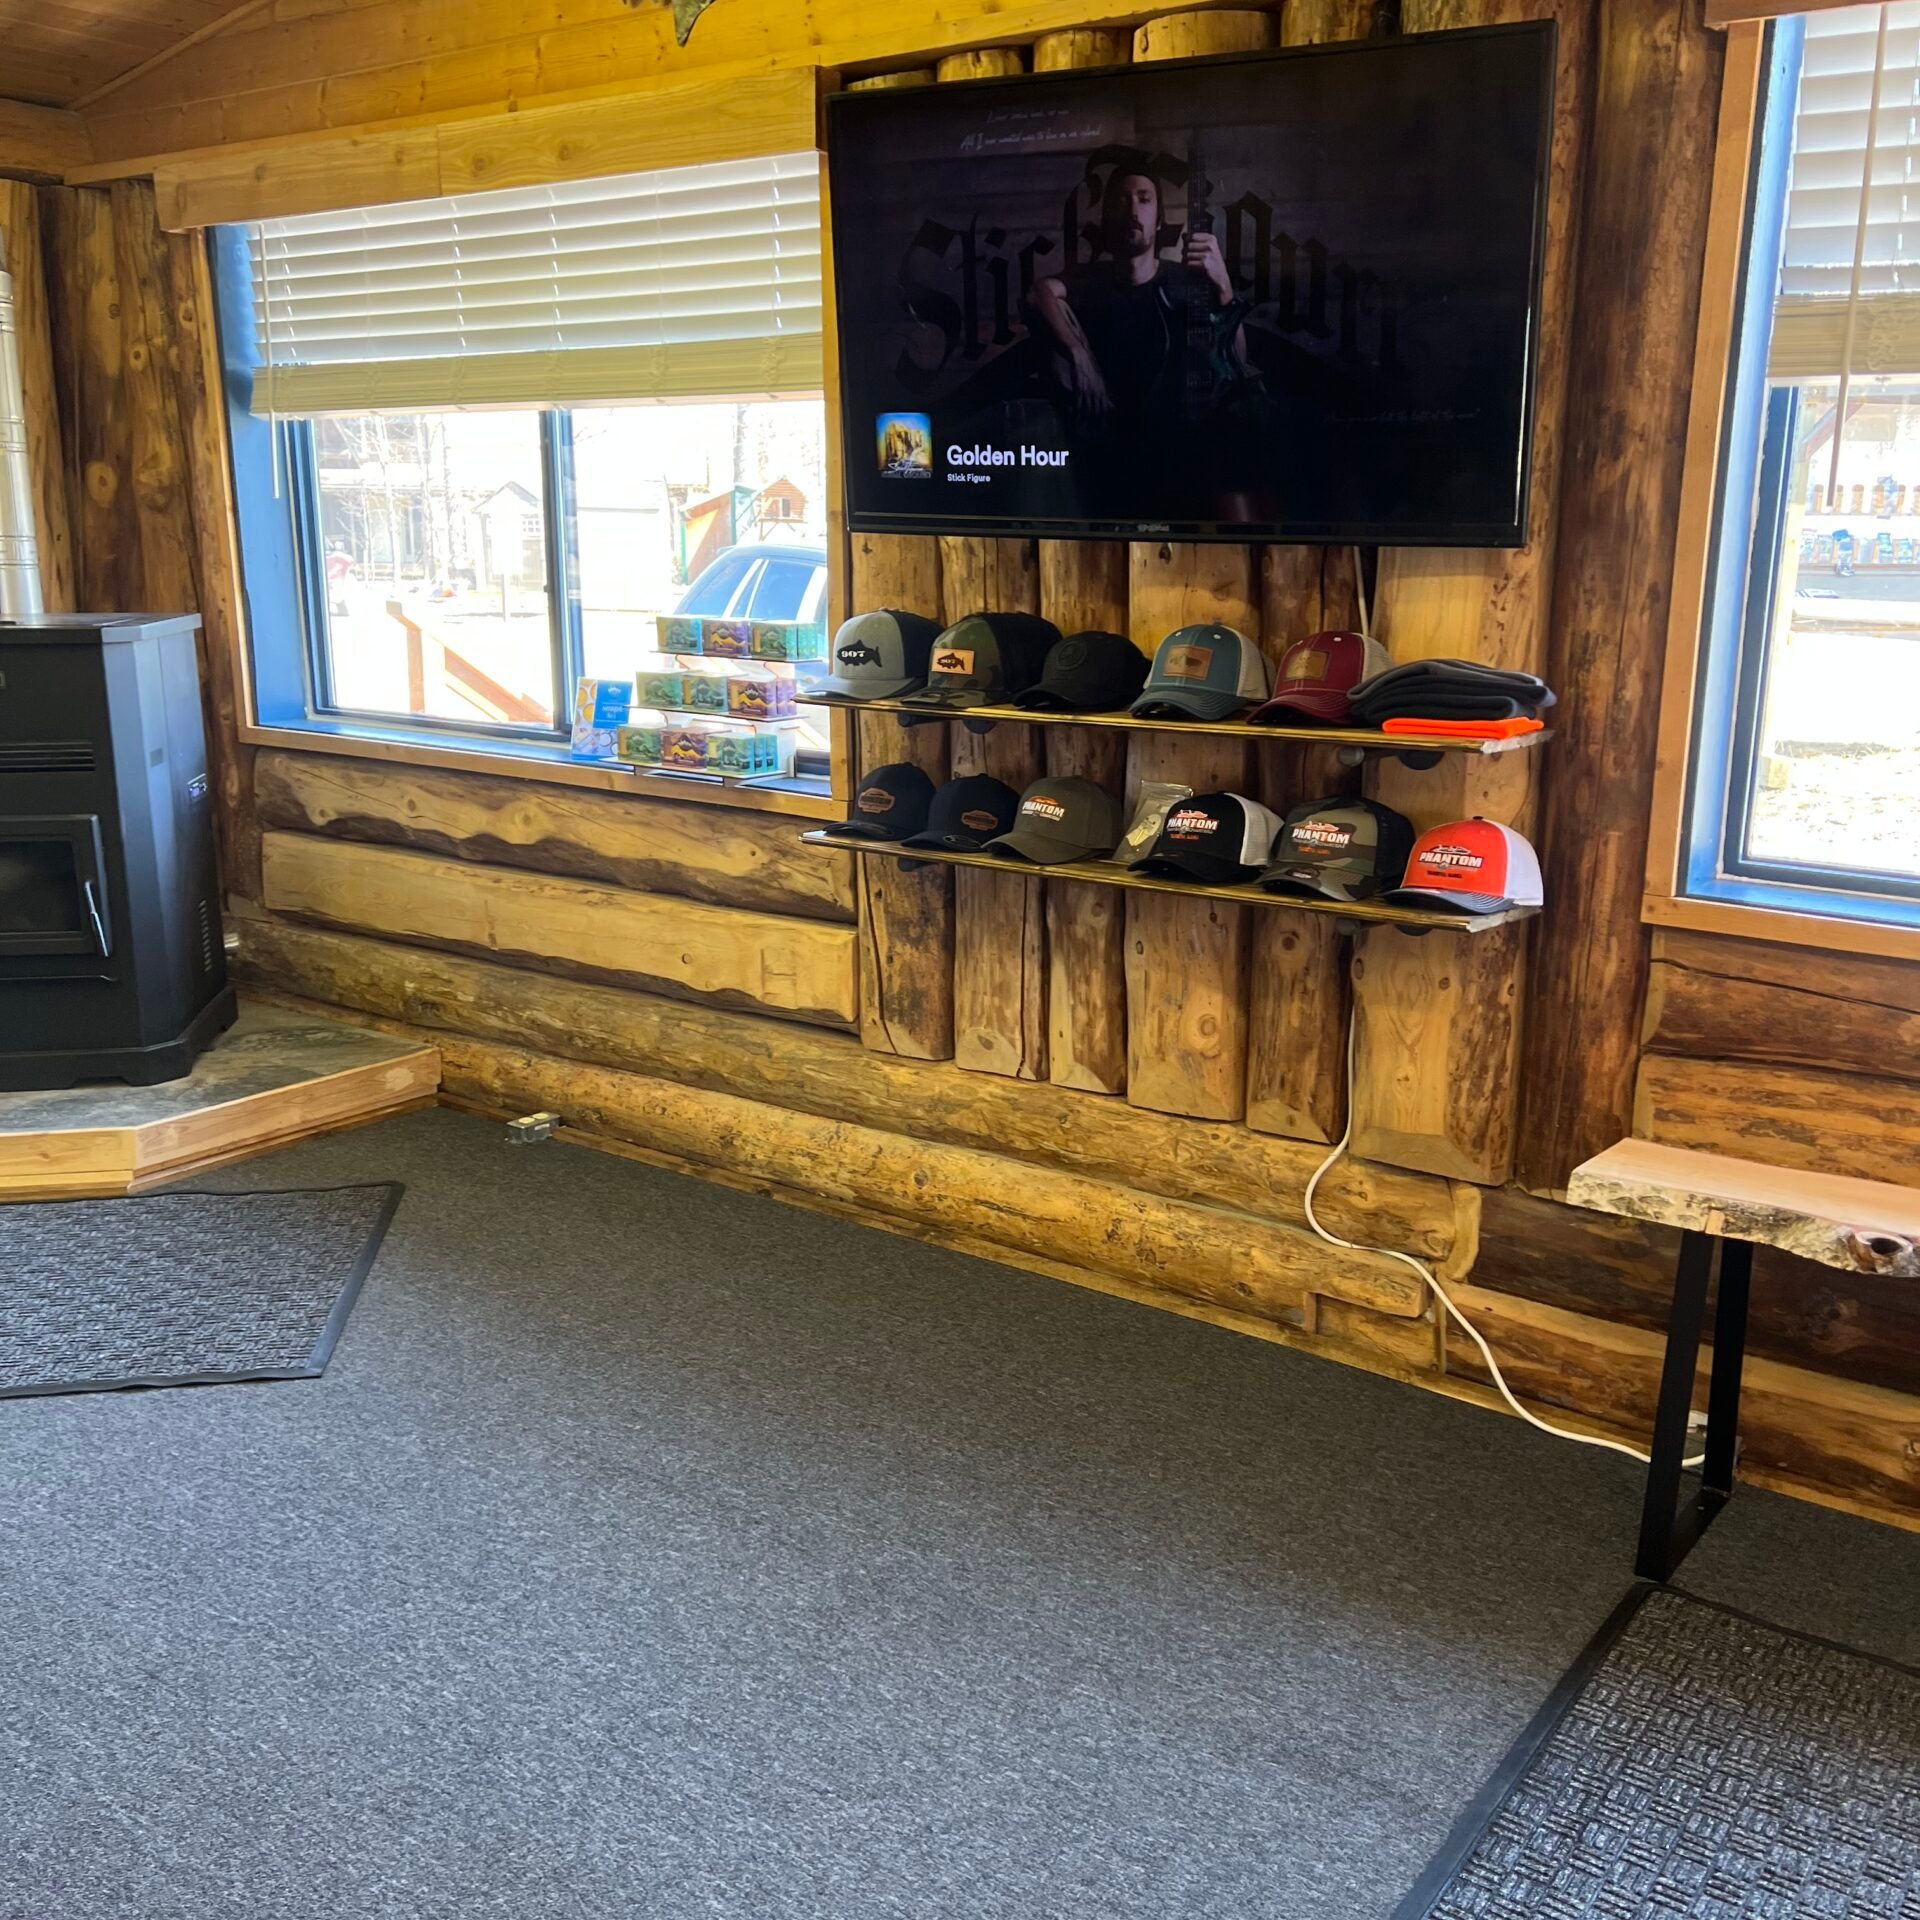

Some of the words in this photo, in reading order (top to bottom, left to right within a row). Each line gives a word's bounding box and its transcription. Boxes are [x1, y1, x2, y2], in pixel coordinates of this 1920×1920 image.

[946, 444, 1016, 466] Golden
[1020, 444, 1070, 466] Hour
[947, 473, 966, 482] Stick
[966, 473, 991, 484] Figure
[841, 650, 866, 658] 907
[1022, 801, 1066, 817] PHANTOM
[1167, 818, 1218, 830] PHANTOM
[1292, 828, 1351, 844] PHANTOM
[1419, 852, 1483, 868] PHANTOM
